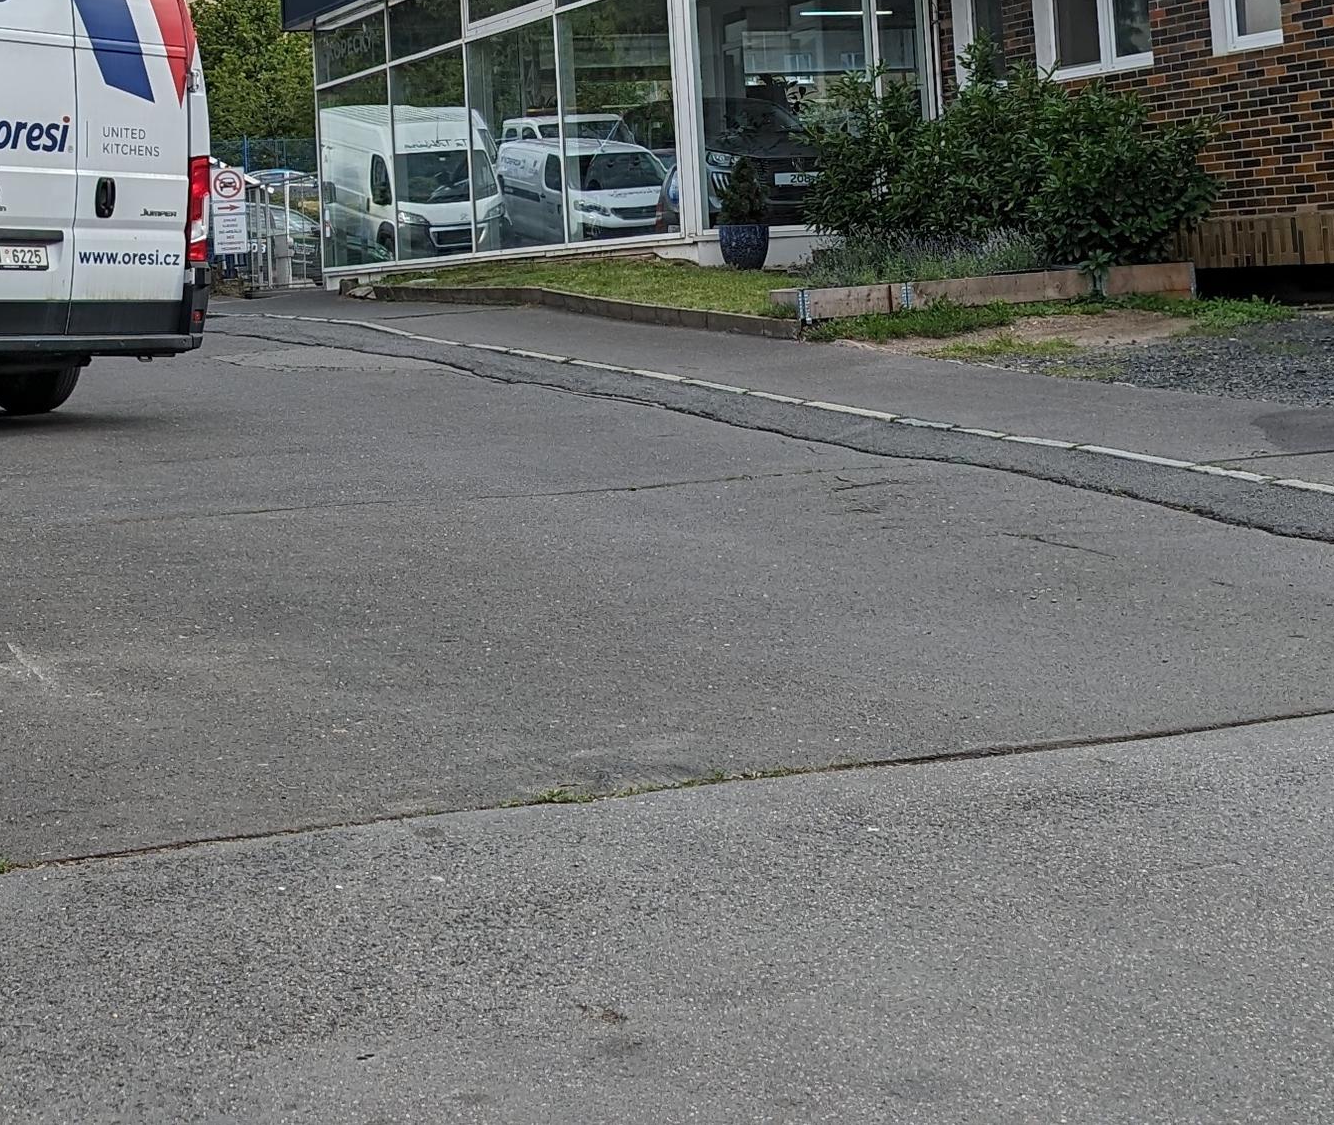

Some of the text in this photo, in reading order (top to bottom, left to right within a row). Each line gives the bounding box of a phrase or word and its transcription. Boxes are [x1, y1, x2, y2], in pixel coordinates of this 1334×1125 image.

[102, 126, 146, 140] UNITED
[102, 143, 160, 157] KITCHENS
[12, 249, 42, 265] 6225
[78, 249, 180, 266] www.oresi.cz
